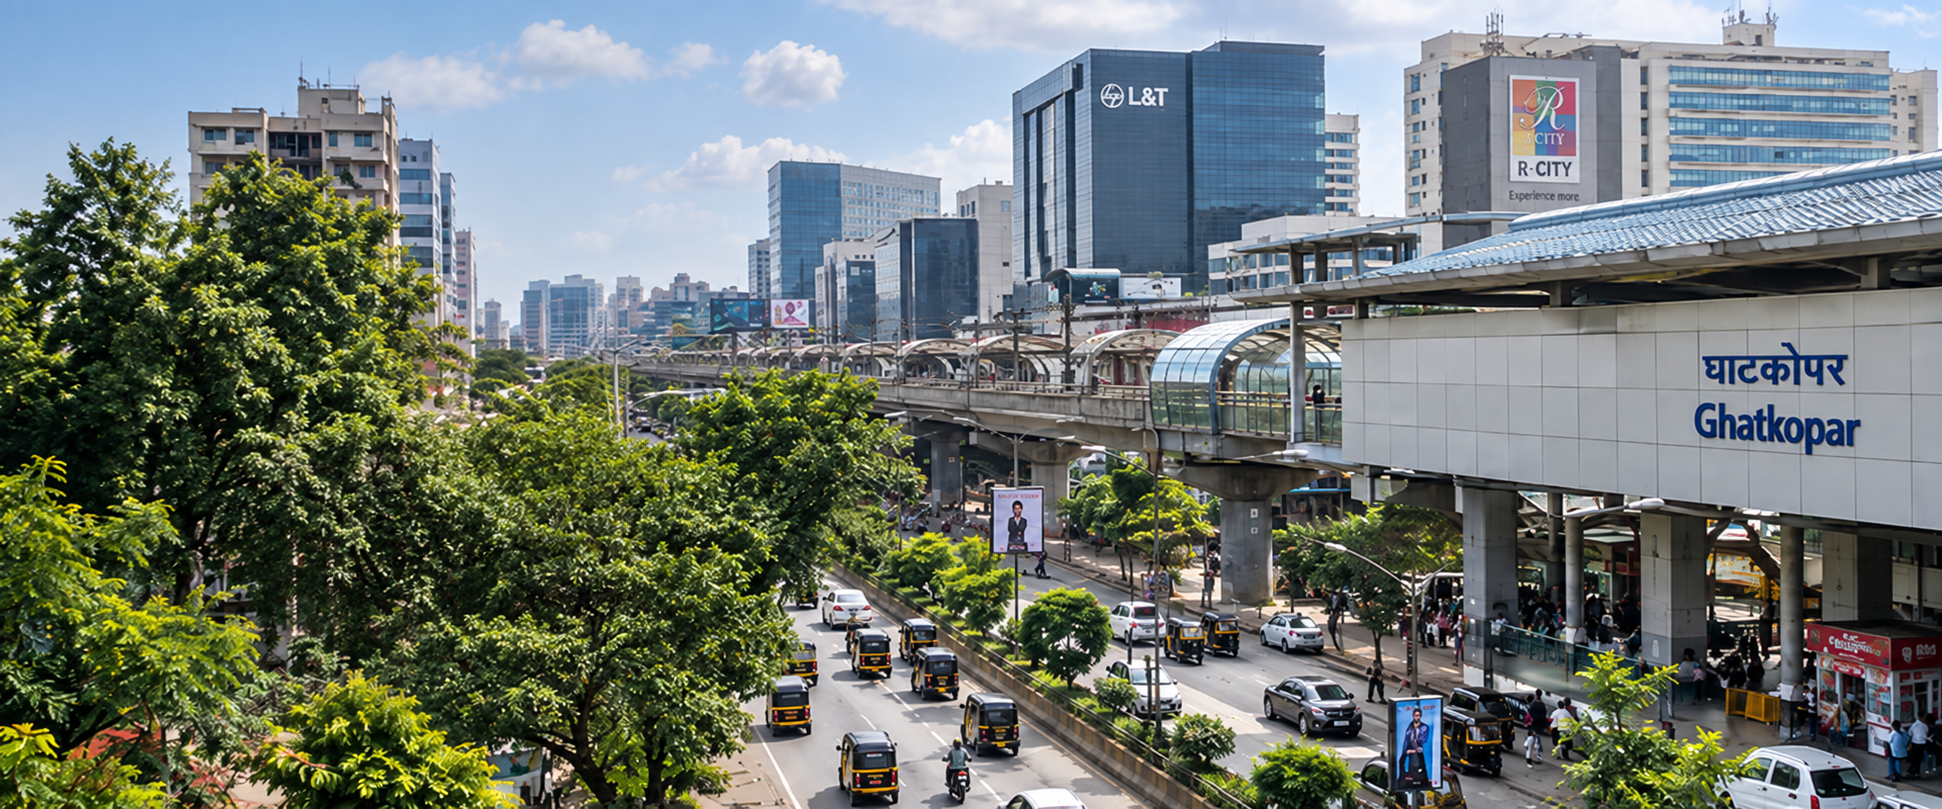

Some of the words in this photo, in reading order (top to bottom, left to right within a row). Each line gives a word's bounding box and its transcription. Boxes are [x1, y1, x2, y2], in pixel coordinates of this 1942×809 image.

[1128, 86, 1169, 107] L&T
[1509, 189, 1556, 203] Experience
[1557, 192, 1580, 201] more
[1702, 342, 1848, 386] घाटकोपर
[1694, 402, 1861, 455] Ghatkopar
